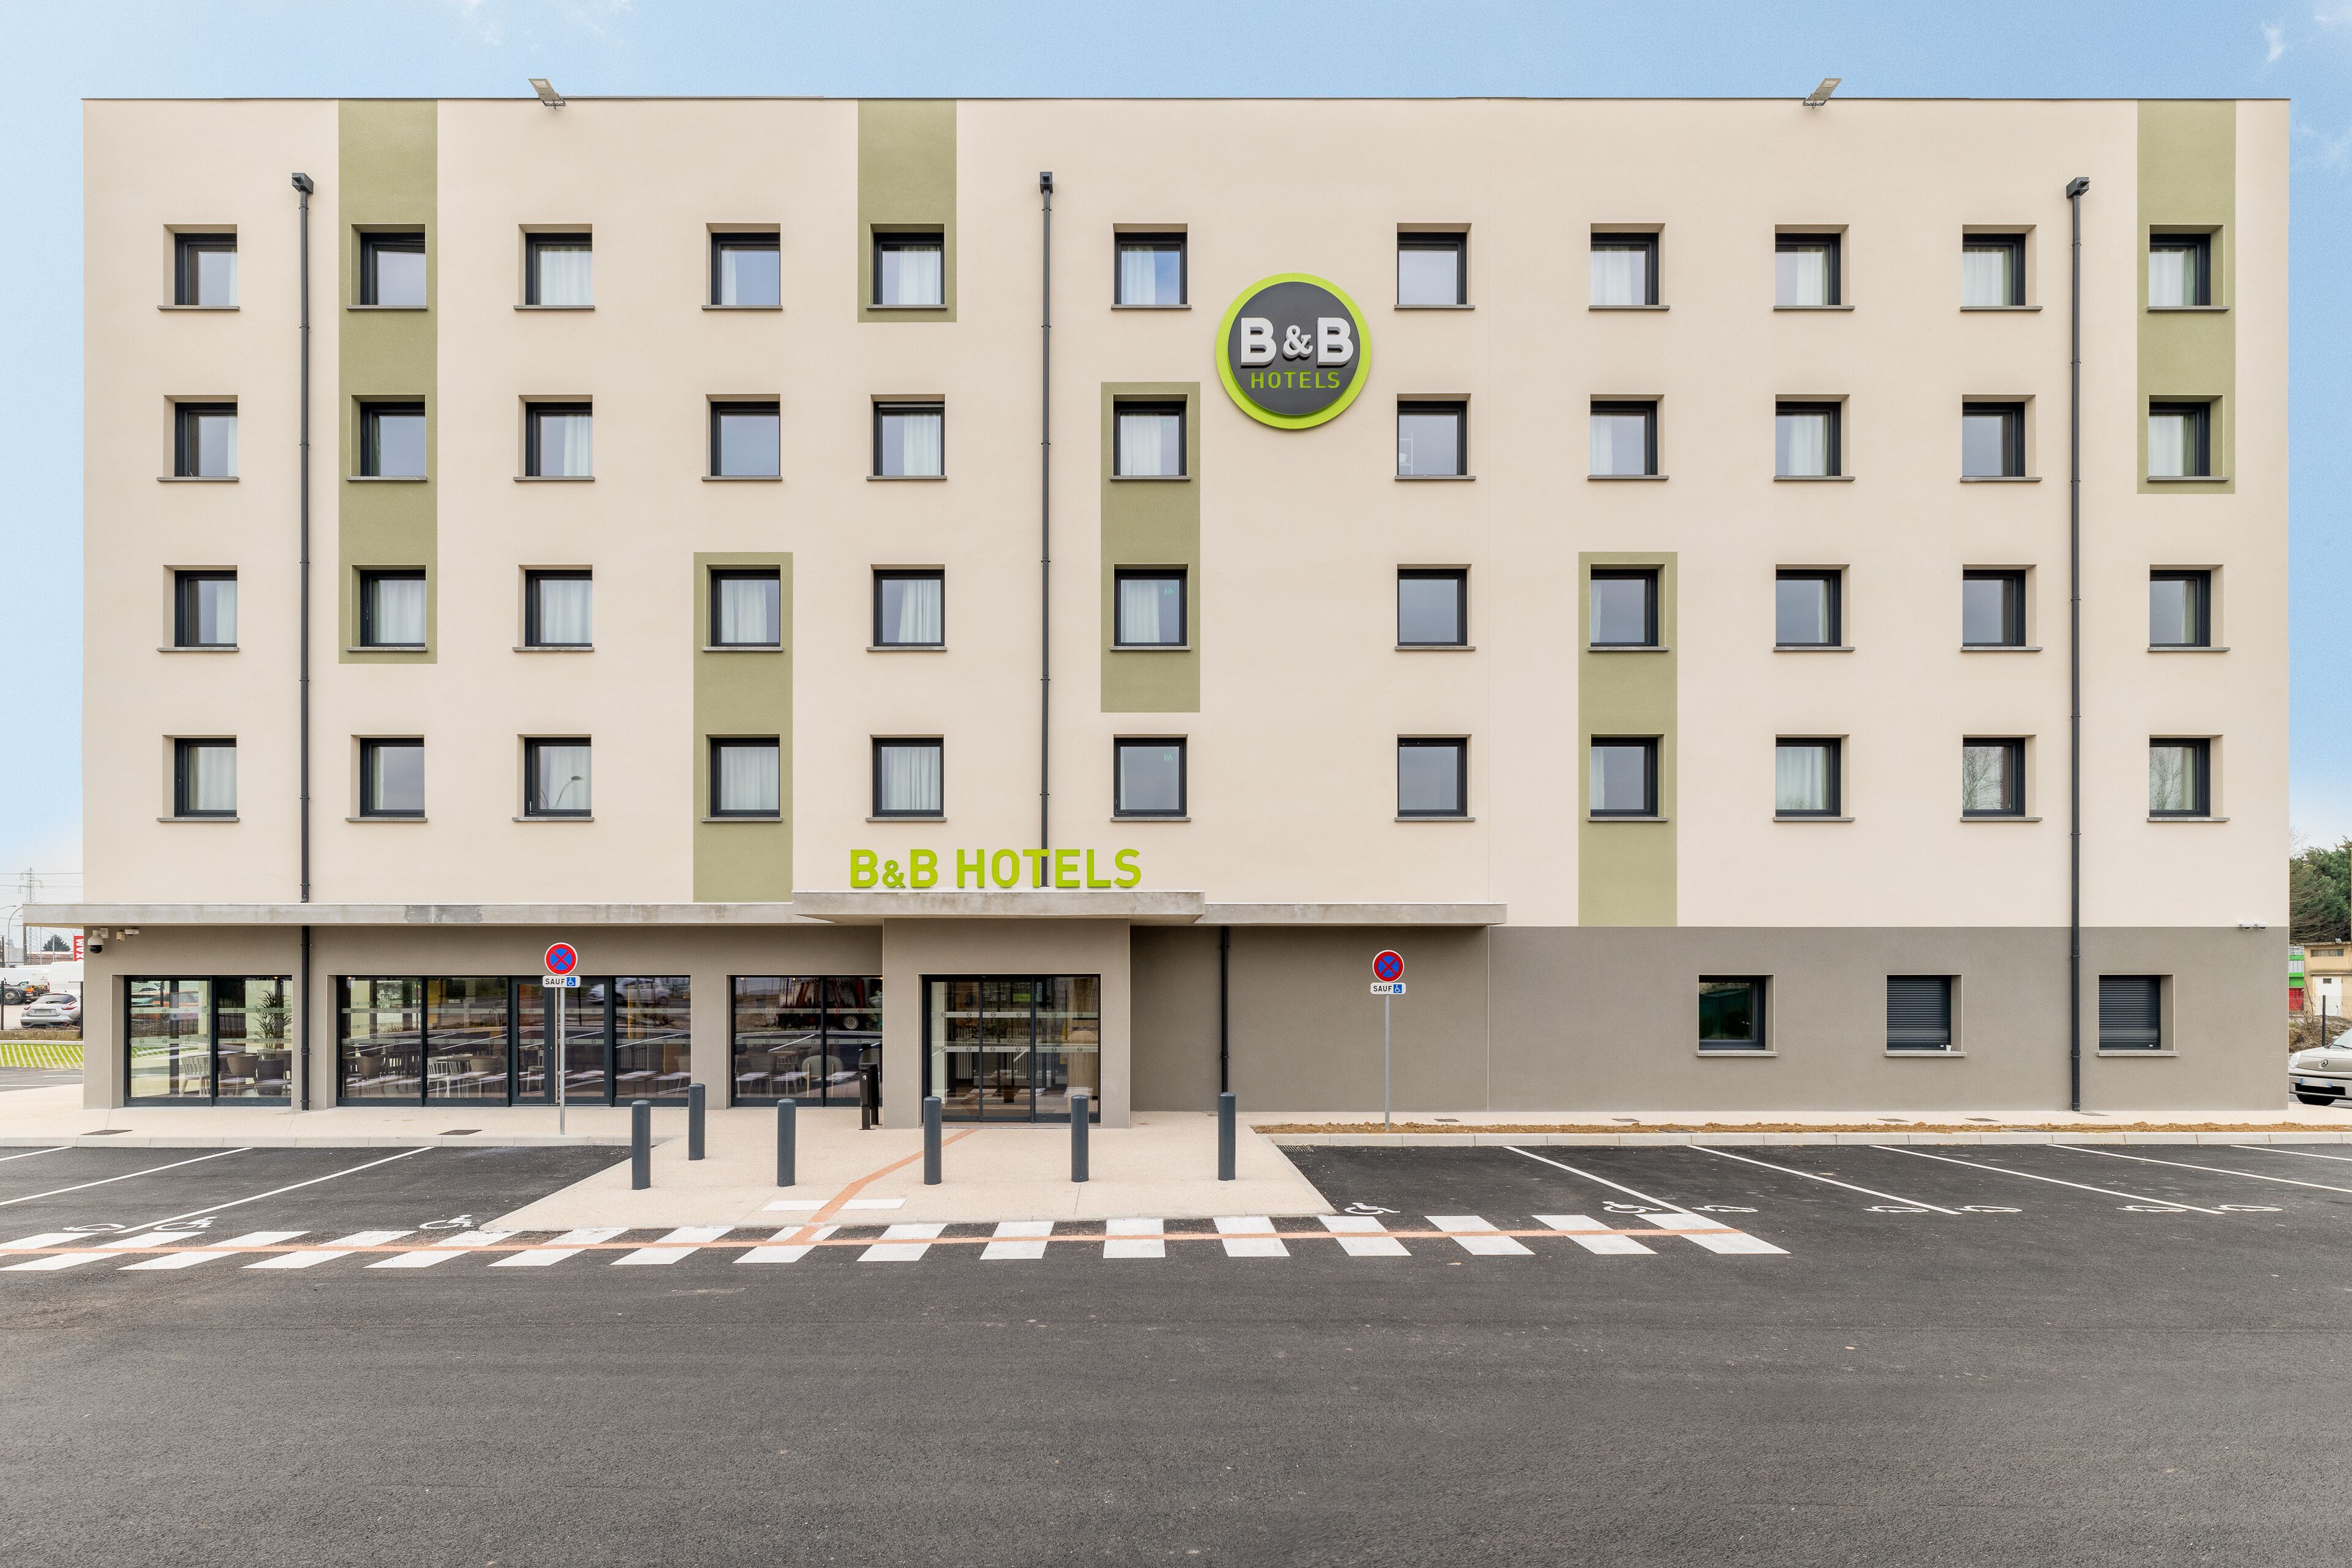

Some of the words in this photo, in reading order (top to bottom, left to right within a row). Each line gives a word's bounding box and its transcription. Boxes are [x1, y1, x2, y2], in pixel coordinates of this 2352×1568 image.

[1241, 317, 1354, 366] B&B
[1251, 372, 1340, 389] HOTELS
[850, 849, 938, 888] B&B
[957, 848, 1142, 888] HOTELS
